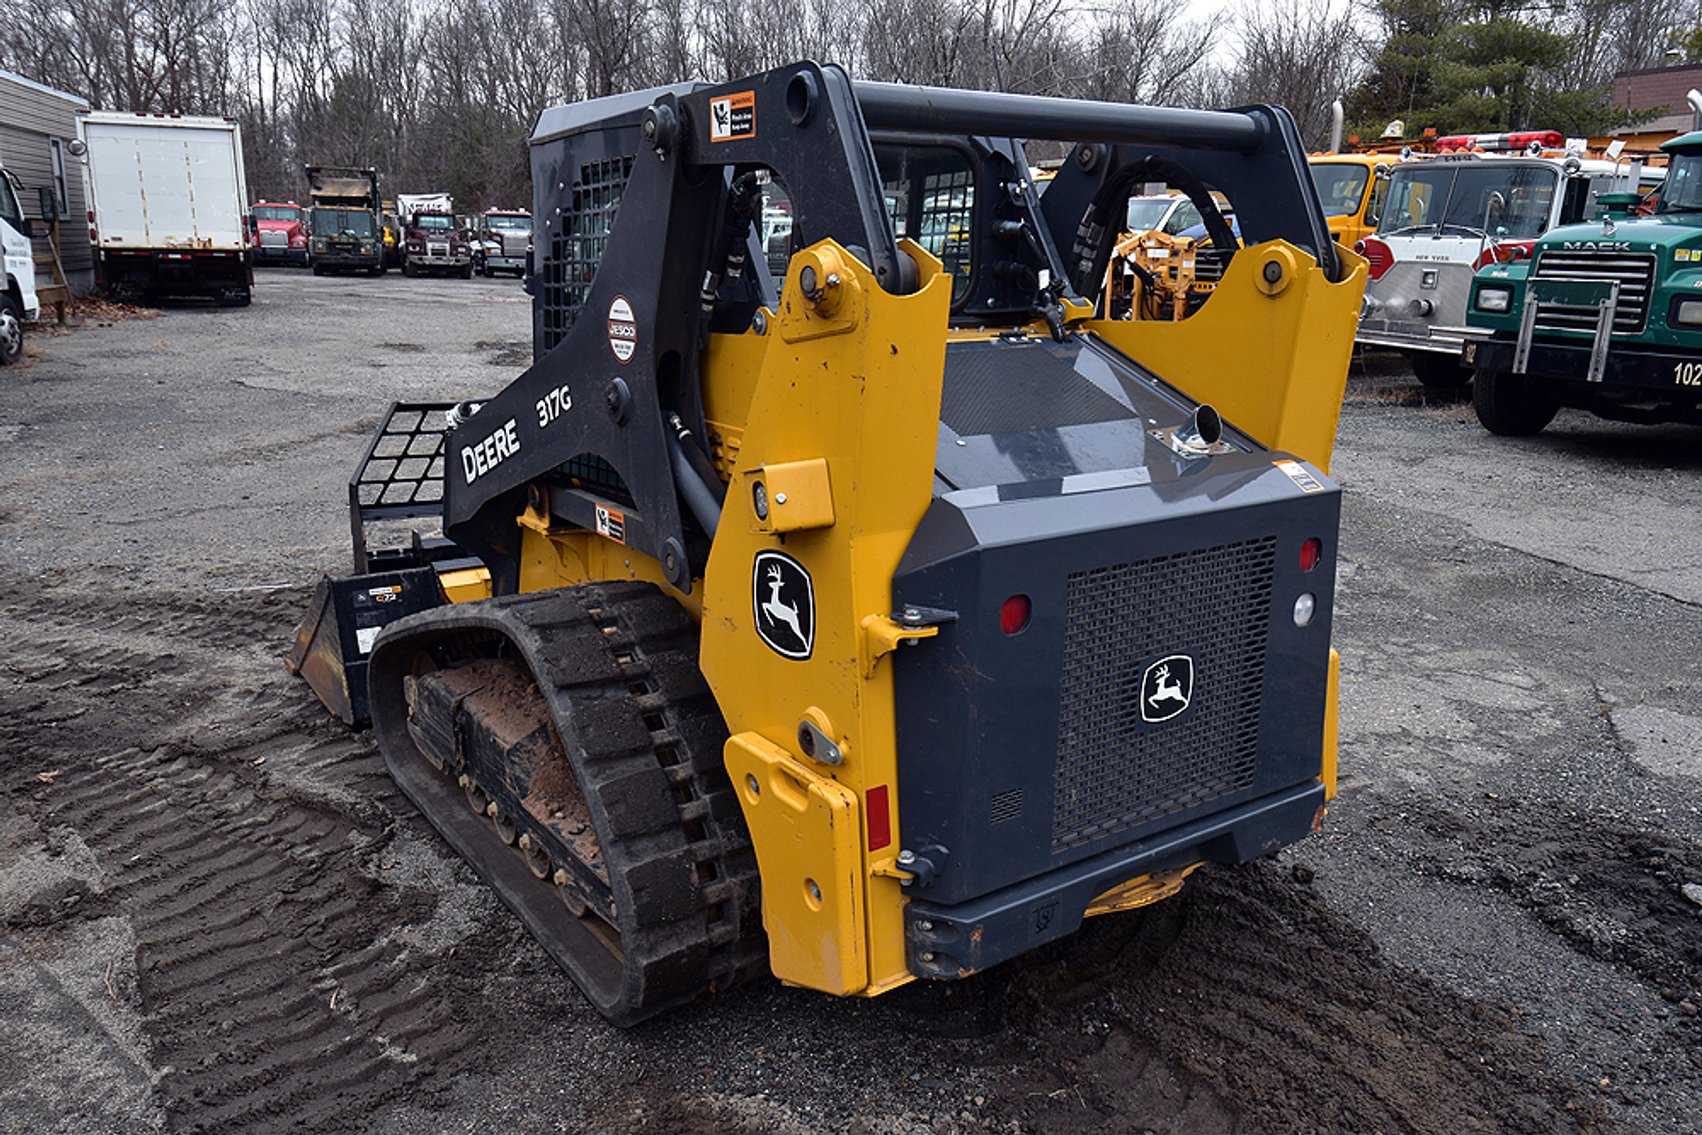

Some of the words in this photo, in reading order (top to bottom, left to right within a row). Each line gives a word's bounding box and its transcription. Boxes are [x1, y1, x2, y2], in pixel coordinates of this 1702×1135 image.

[1563, 241, 1631, 251] MACK
[610, 324, 636, 337] JESCO
[461, 418, 521, 484] DEERE
[536, 384, 572, 428] 317G
